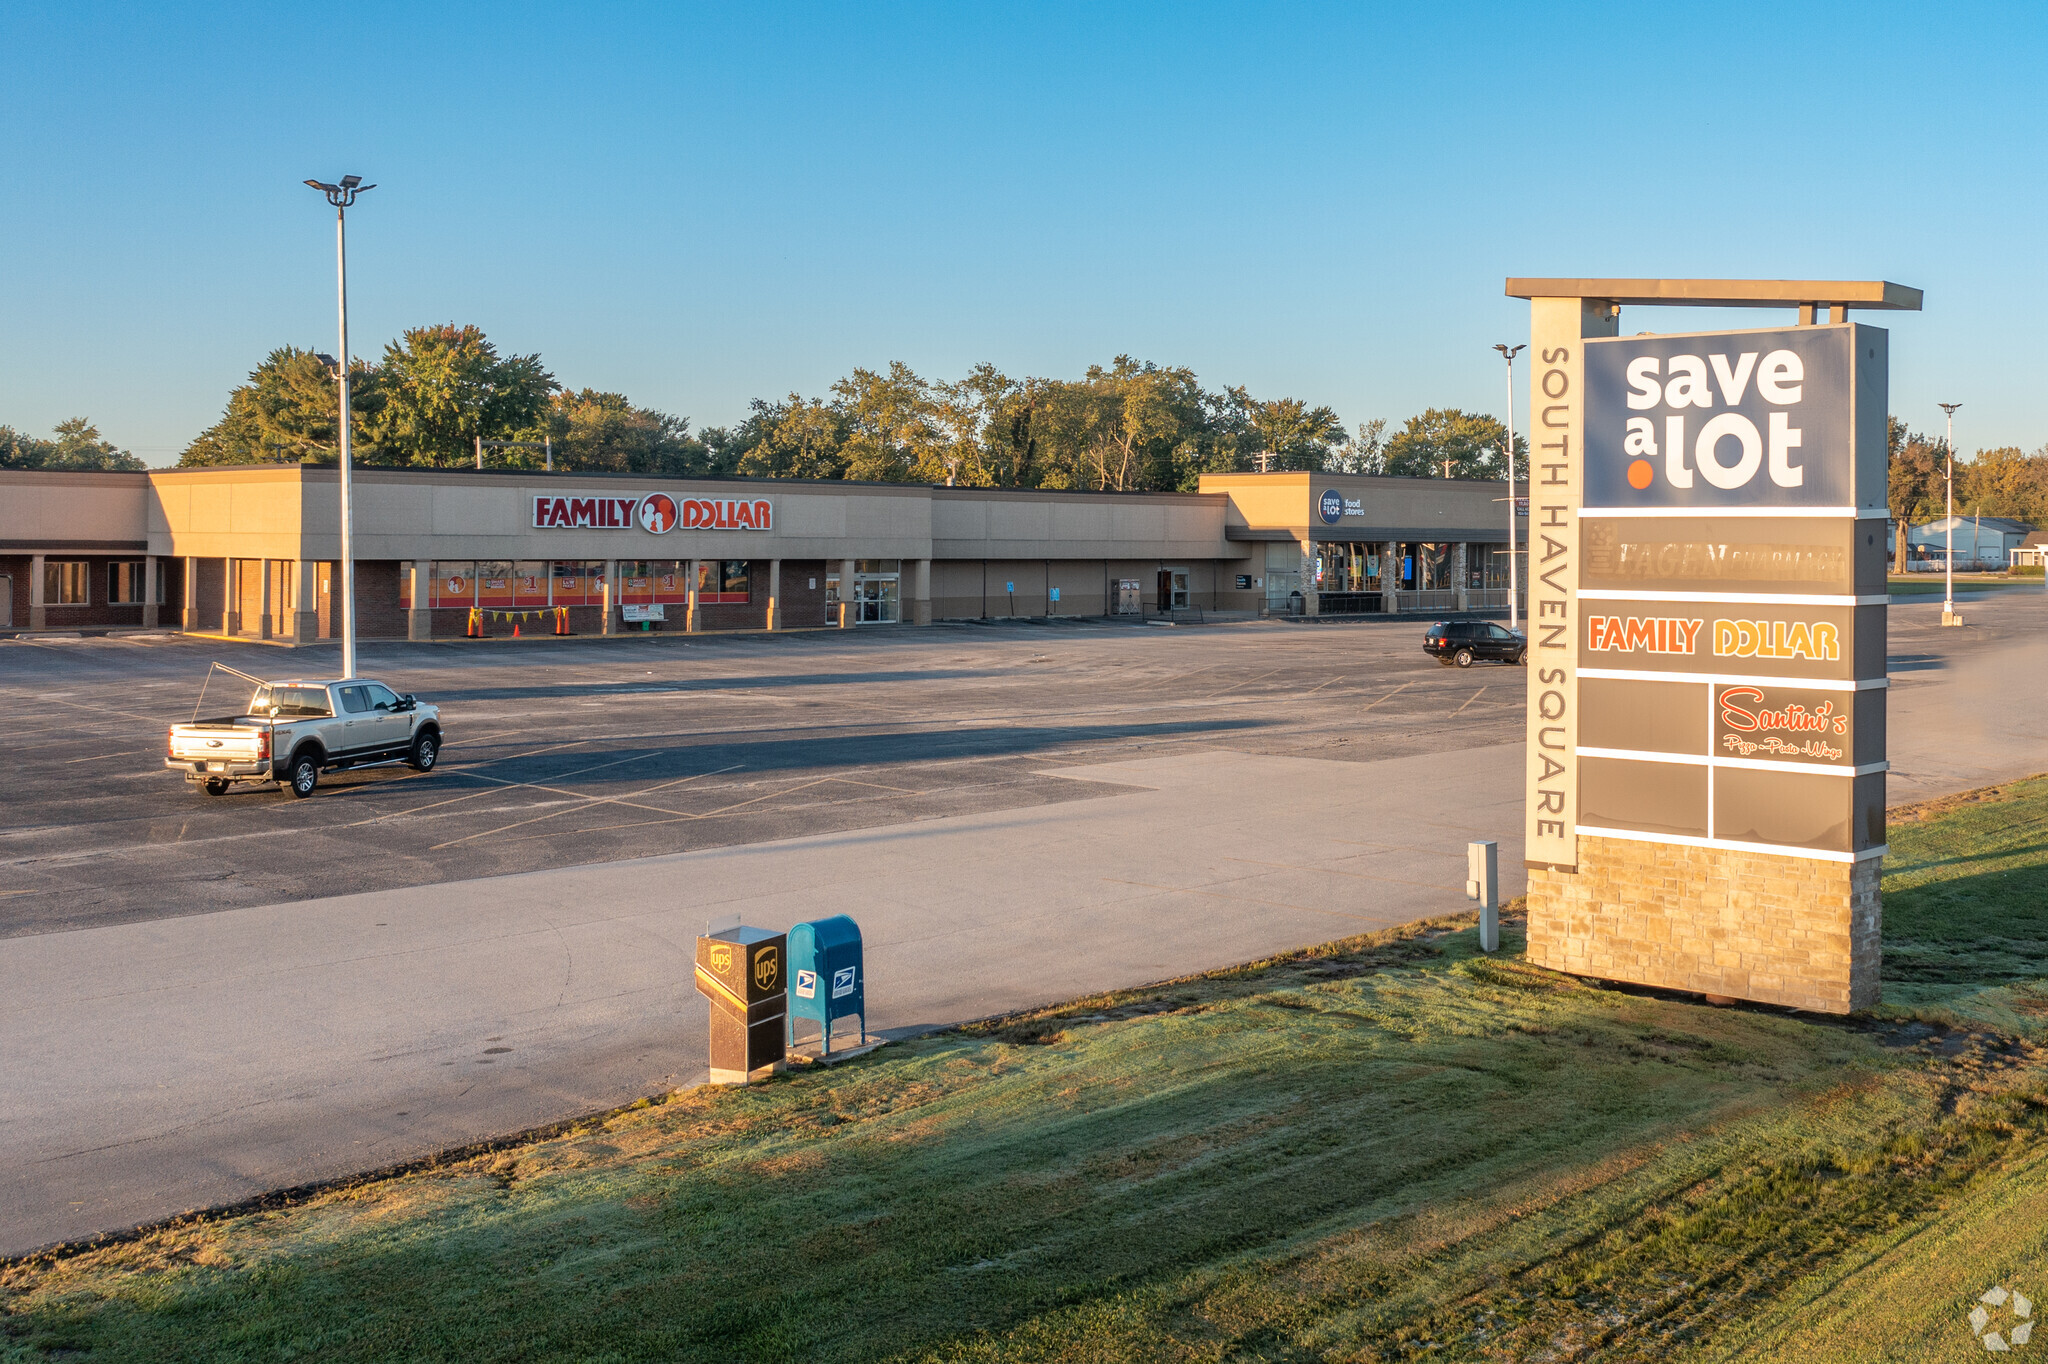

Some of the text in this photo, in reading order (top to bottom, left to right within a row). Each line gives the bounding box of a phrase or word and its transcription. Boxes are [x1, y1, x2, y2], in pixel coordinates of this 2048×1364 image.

[1626, 349, 1804, 410] save
[1623, 411, 1803, 490] a lot
[534, 497, 772, 529] FAMILY DOLLAR
[1323, 498, 1340, 506] save
[1344, 499, 1361, 508] food
[1344, 507, 1365, 516] stores
[1537, 347, 1569, 839] SOUTH HAVEN SQUARE
[1588, 615, 1840, 660] FAMILY DOLLAR
[1719, 686, 1848, 735] Santini's
[1723, 734, 1758, 755] Pizza
[712, 953, 730, 970] ups
[756, 958, 776, 984] ups
